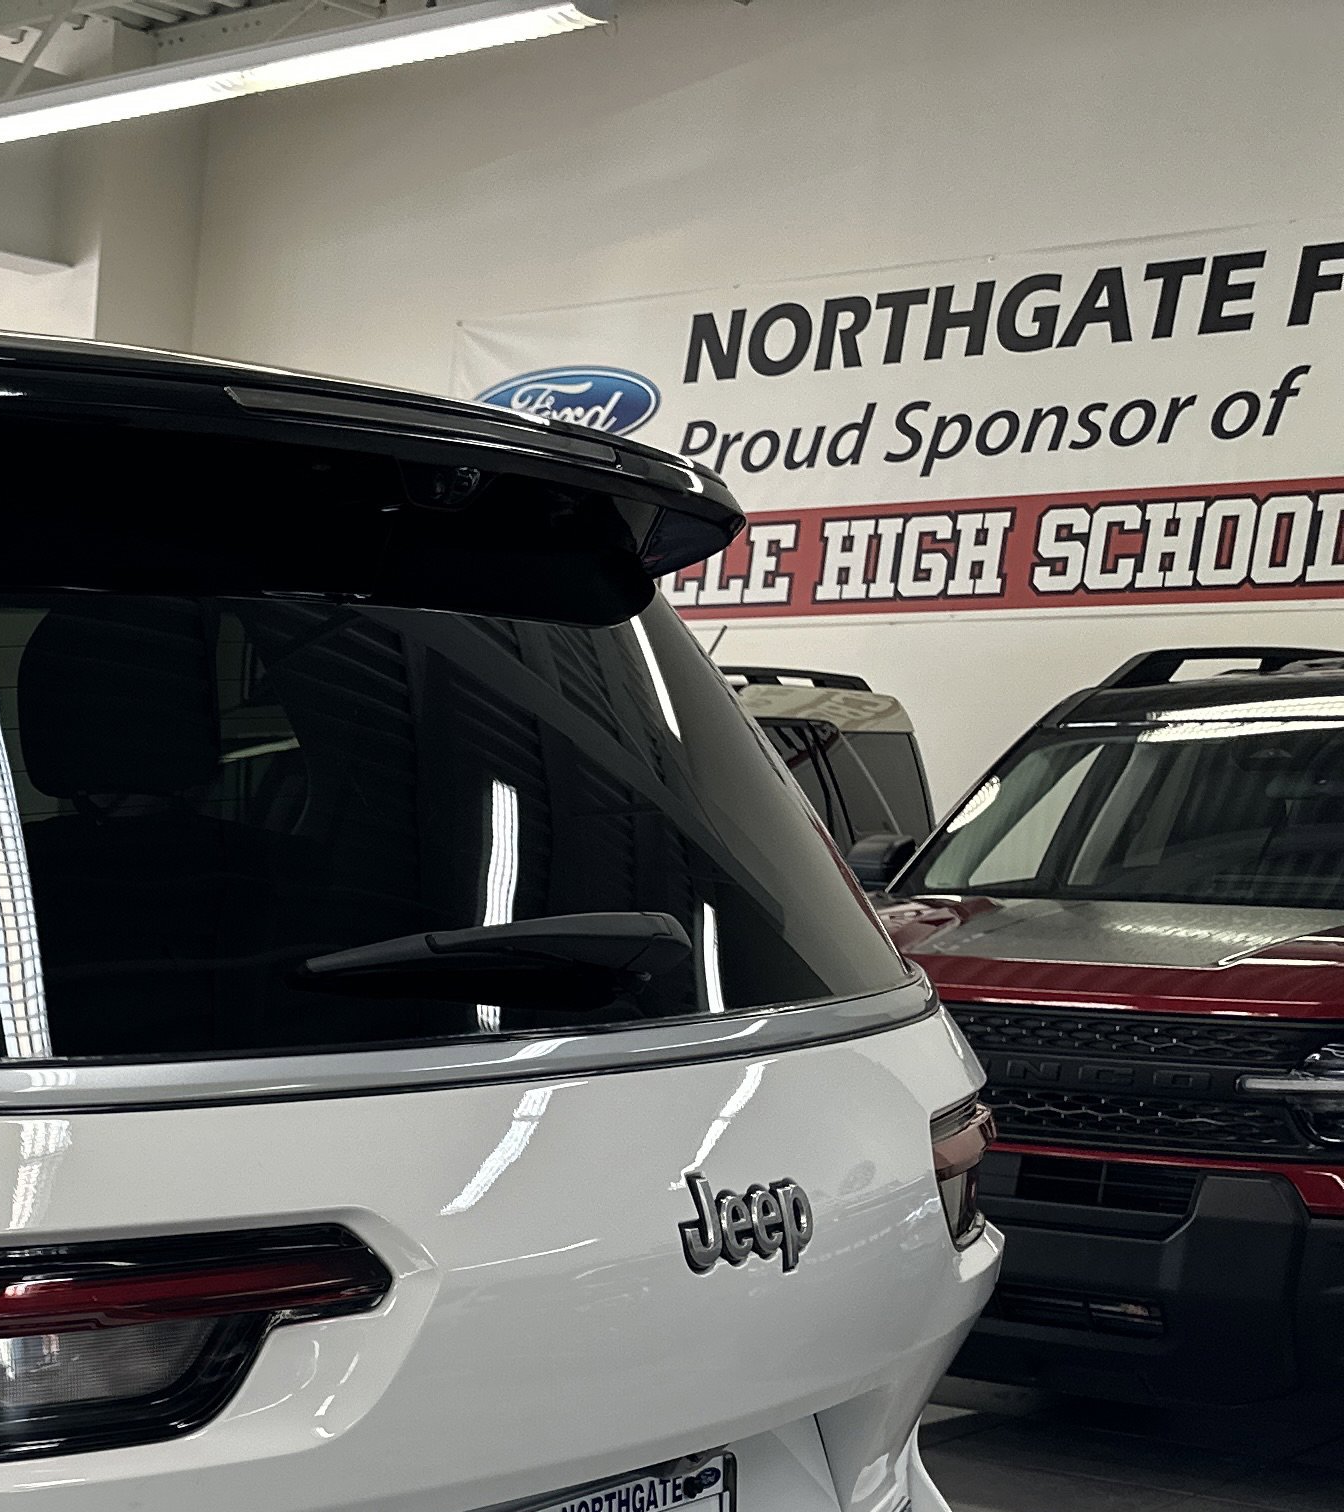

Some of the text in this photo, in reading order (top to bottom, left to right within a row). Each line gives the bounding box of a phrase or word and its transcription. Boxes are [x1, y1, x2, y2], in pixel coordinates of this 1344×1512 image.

[683, 250, 1267, 384] NORTHGATE
[681, 365, 1311, 478] Proud Sponsor of
[814, 508, 1014, 602] HIGH
[678, 1171, 813, 1275] Jeep
